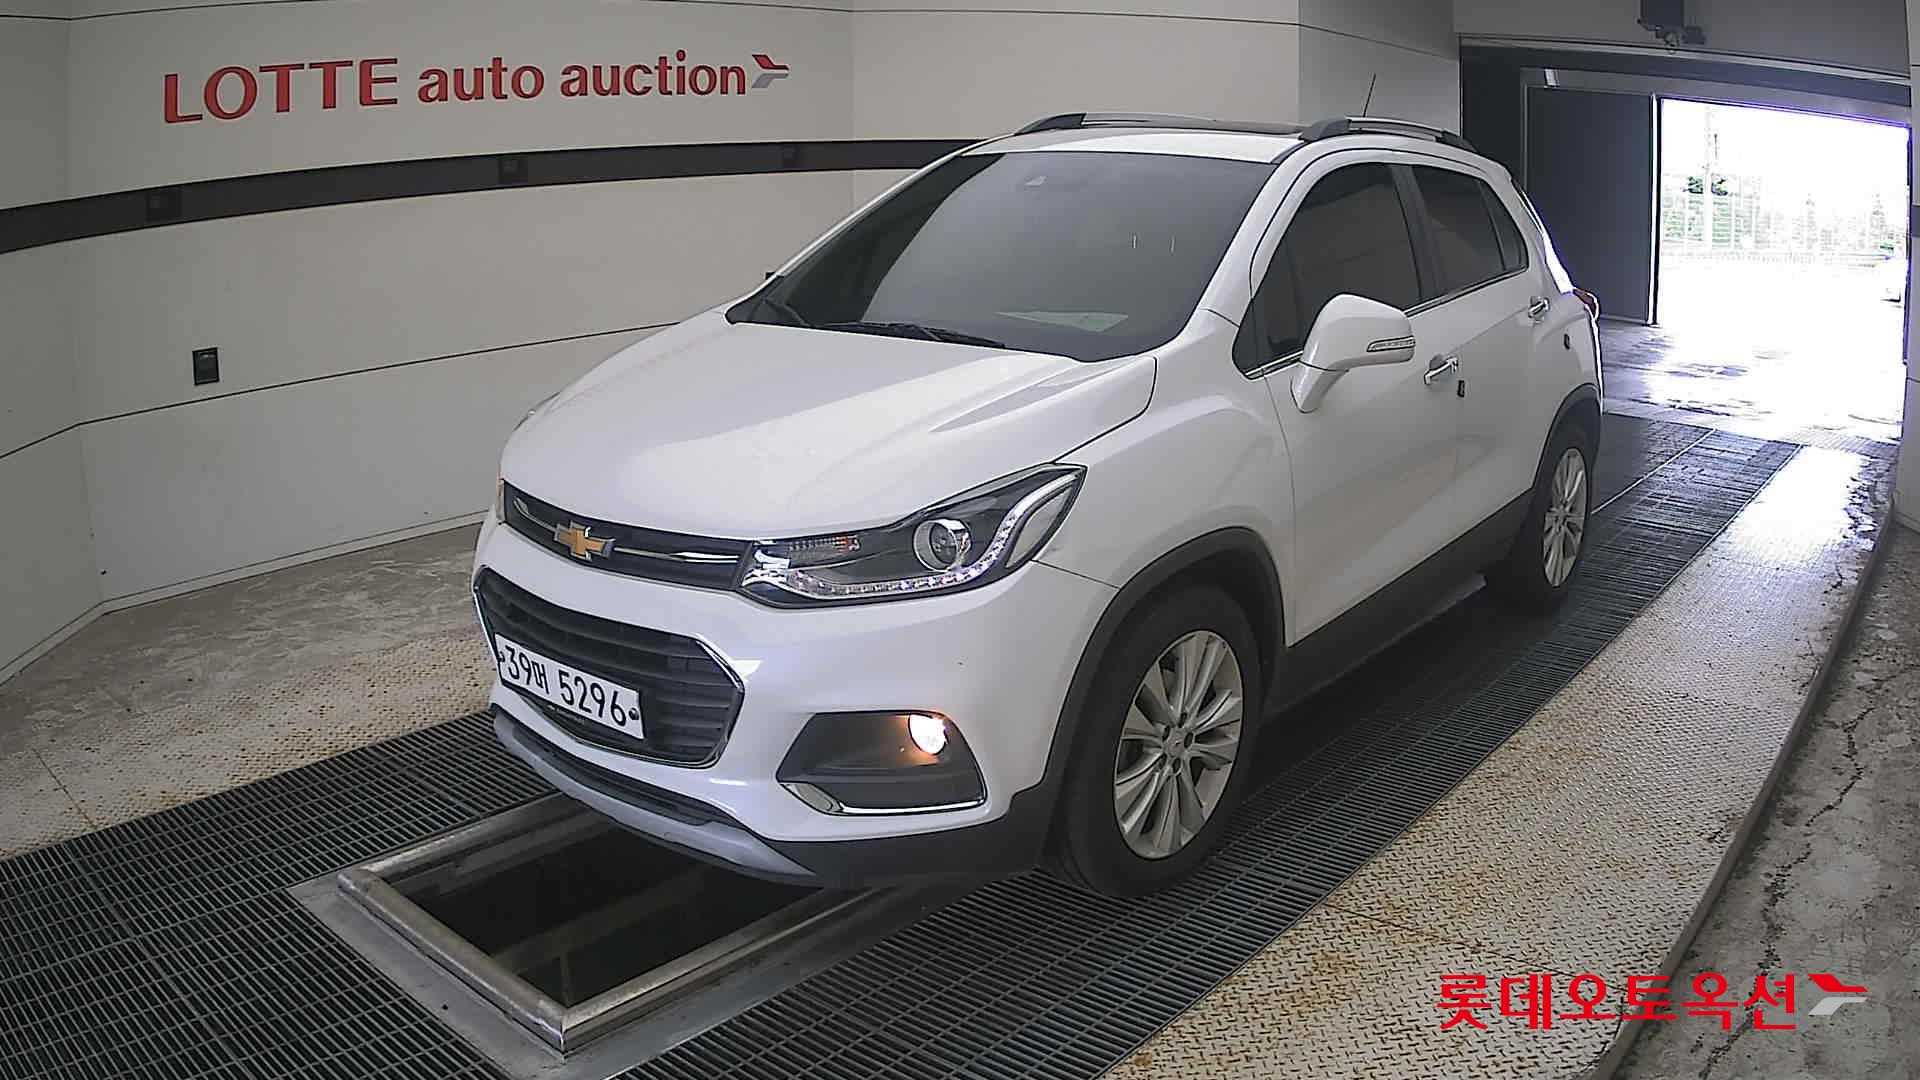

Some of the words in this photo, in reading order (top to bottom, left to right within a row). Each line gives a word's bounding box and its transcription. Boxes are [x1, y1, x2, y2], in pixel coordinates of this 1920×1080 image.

[164, 58, 399, 125] LOTTE
[418, 58, 545, 104] auto
[559, 50, 747, 98] auction
[504, 645, 550, 695] 39머
[558, 669, 627, 727] 5296
